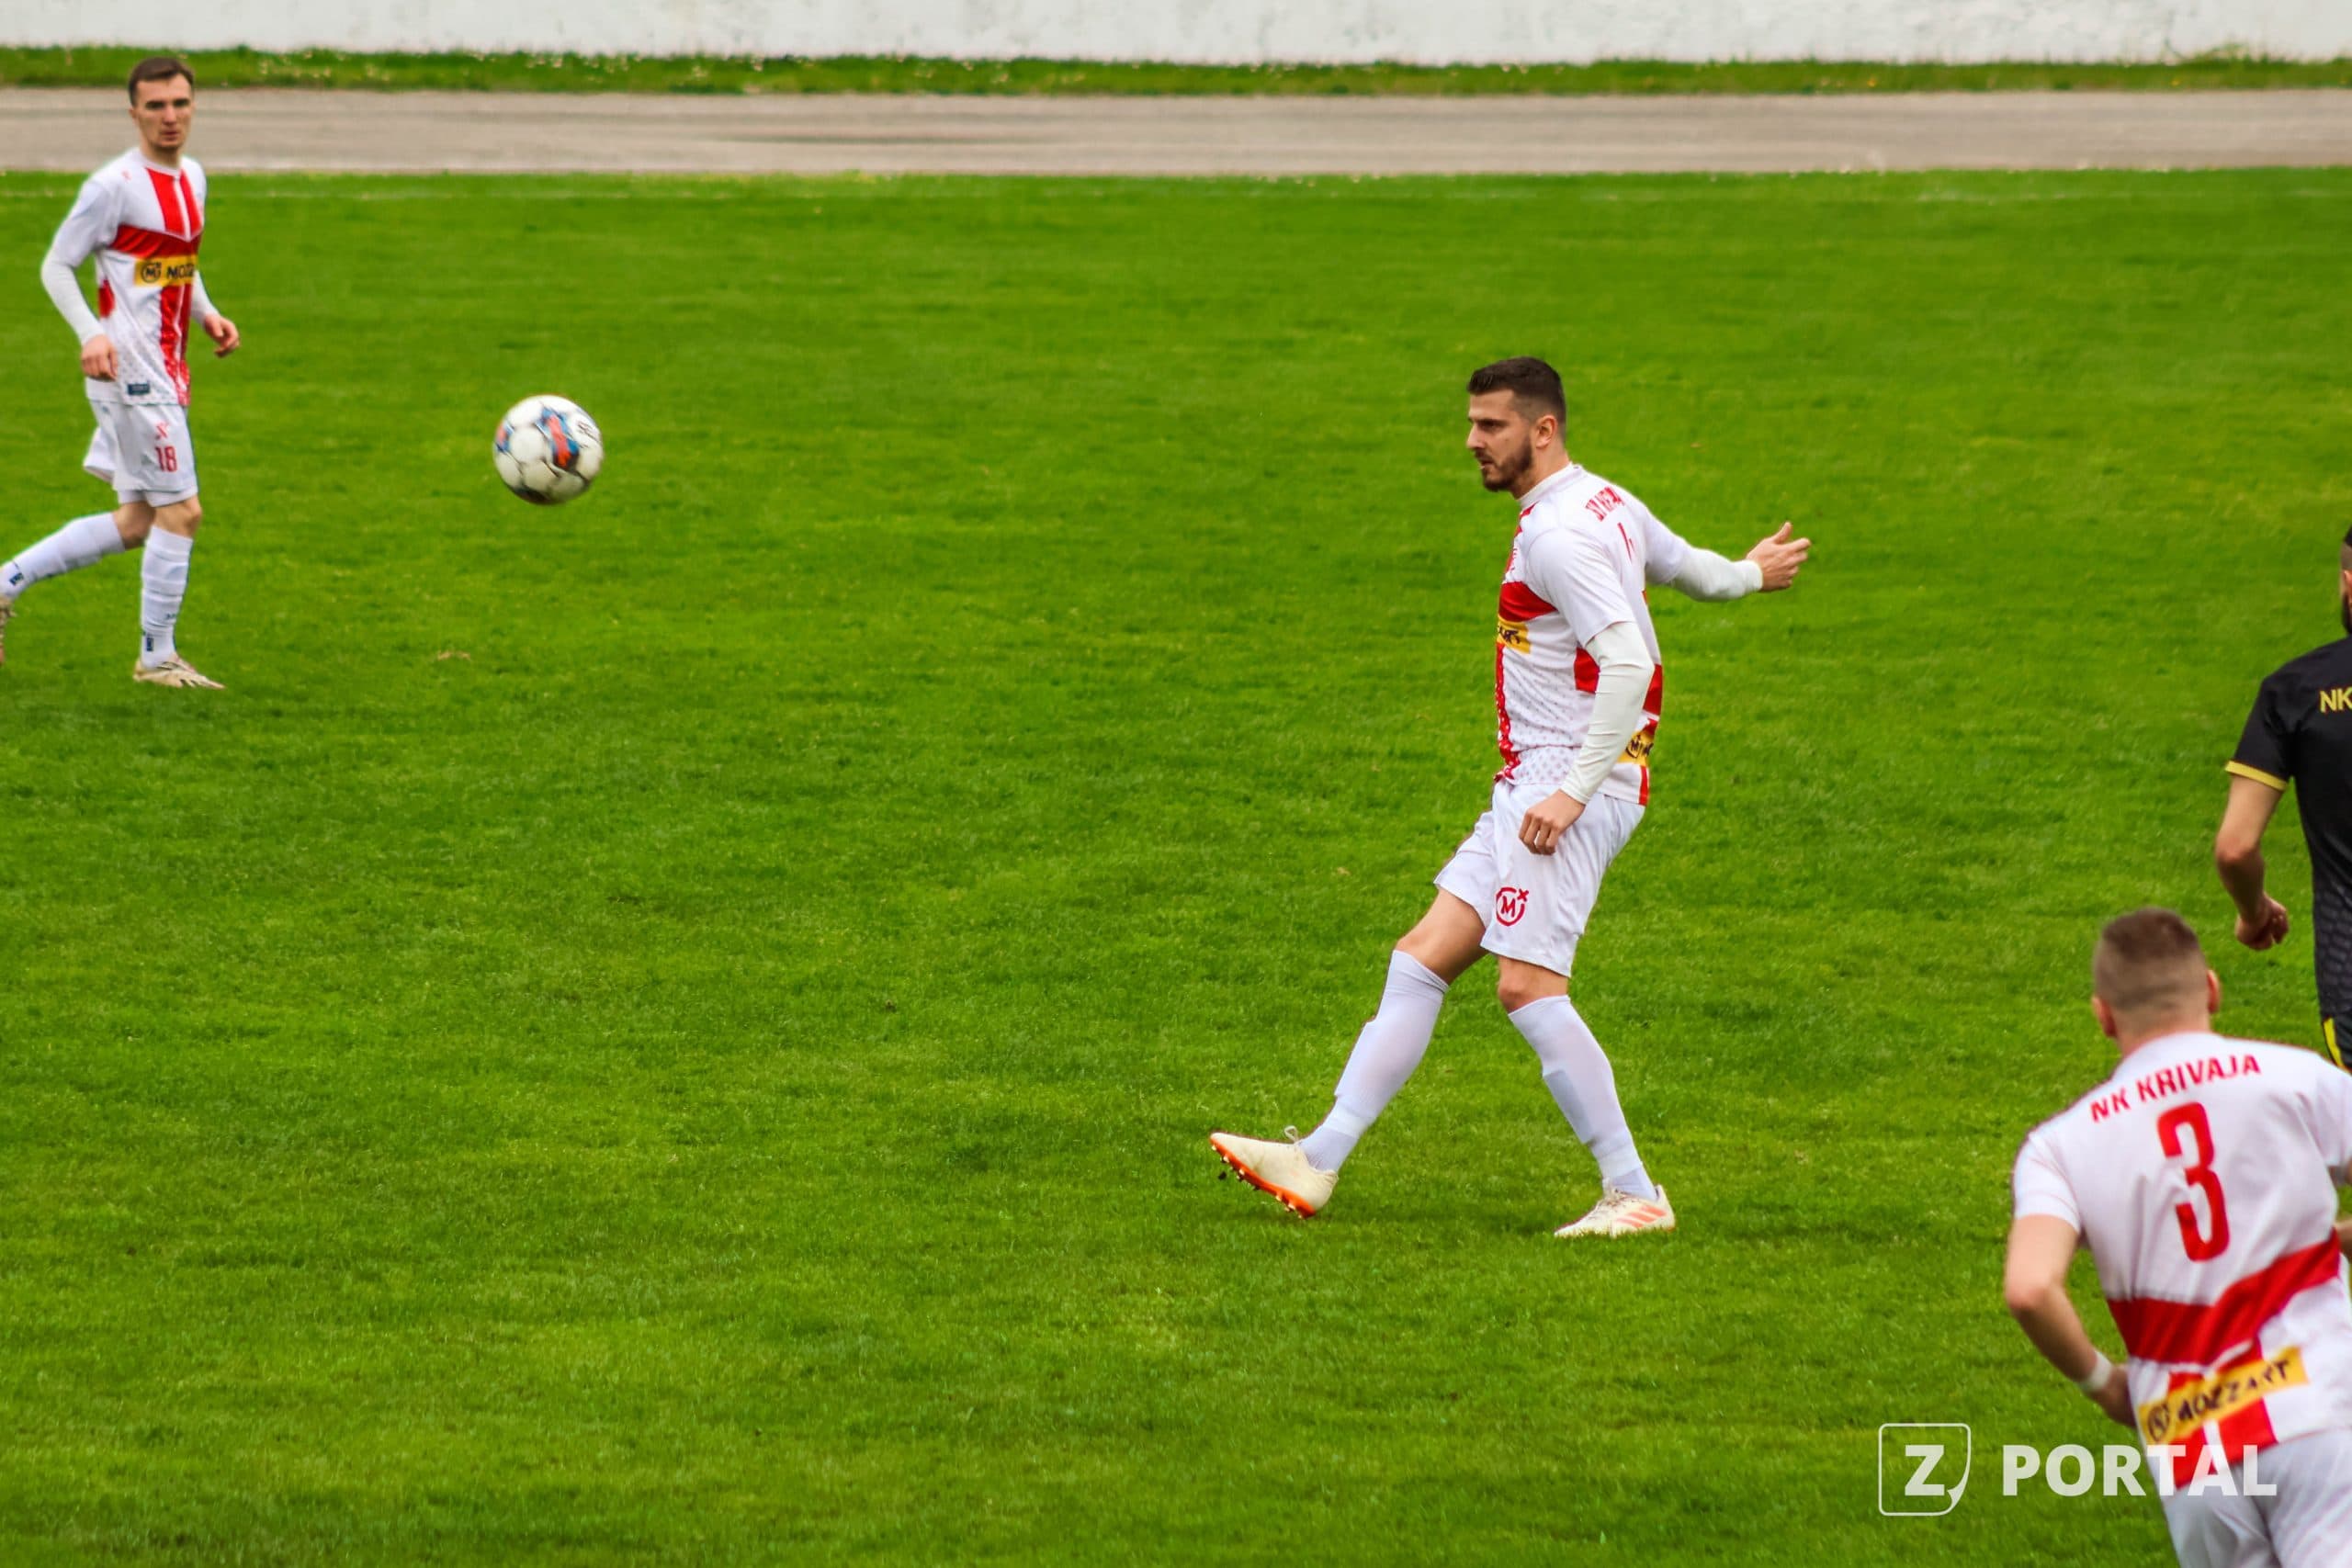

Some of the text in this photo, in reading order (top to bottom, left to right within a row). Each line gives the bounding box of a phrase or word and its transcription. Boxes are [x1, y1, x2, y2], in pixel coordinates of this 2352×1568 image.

[155, 446, 176, 472] 18
[2319, 686, 2352, 714] NK
[2090, 1053, 2262, 1122] NK KRIVAJA
[2156, 1101, 2231, 1263] 3
